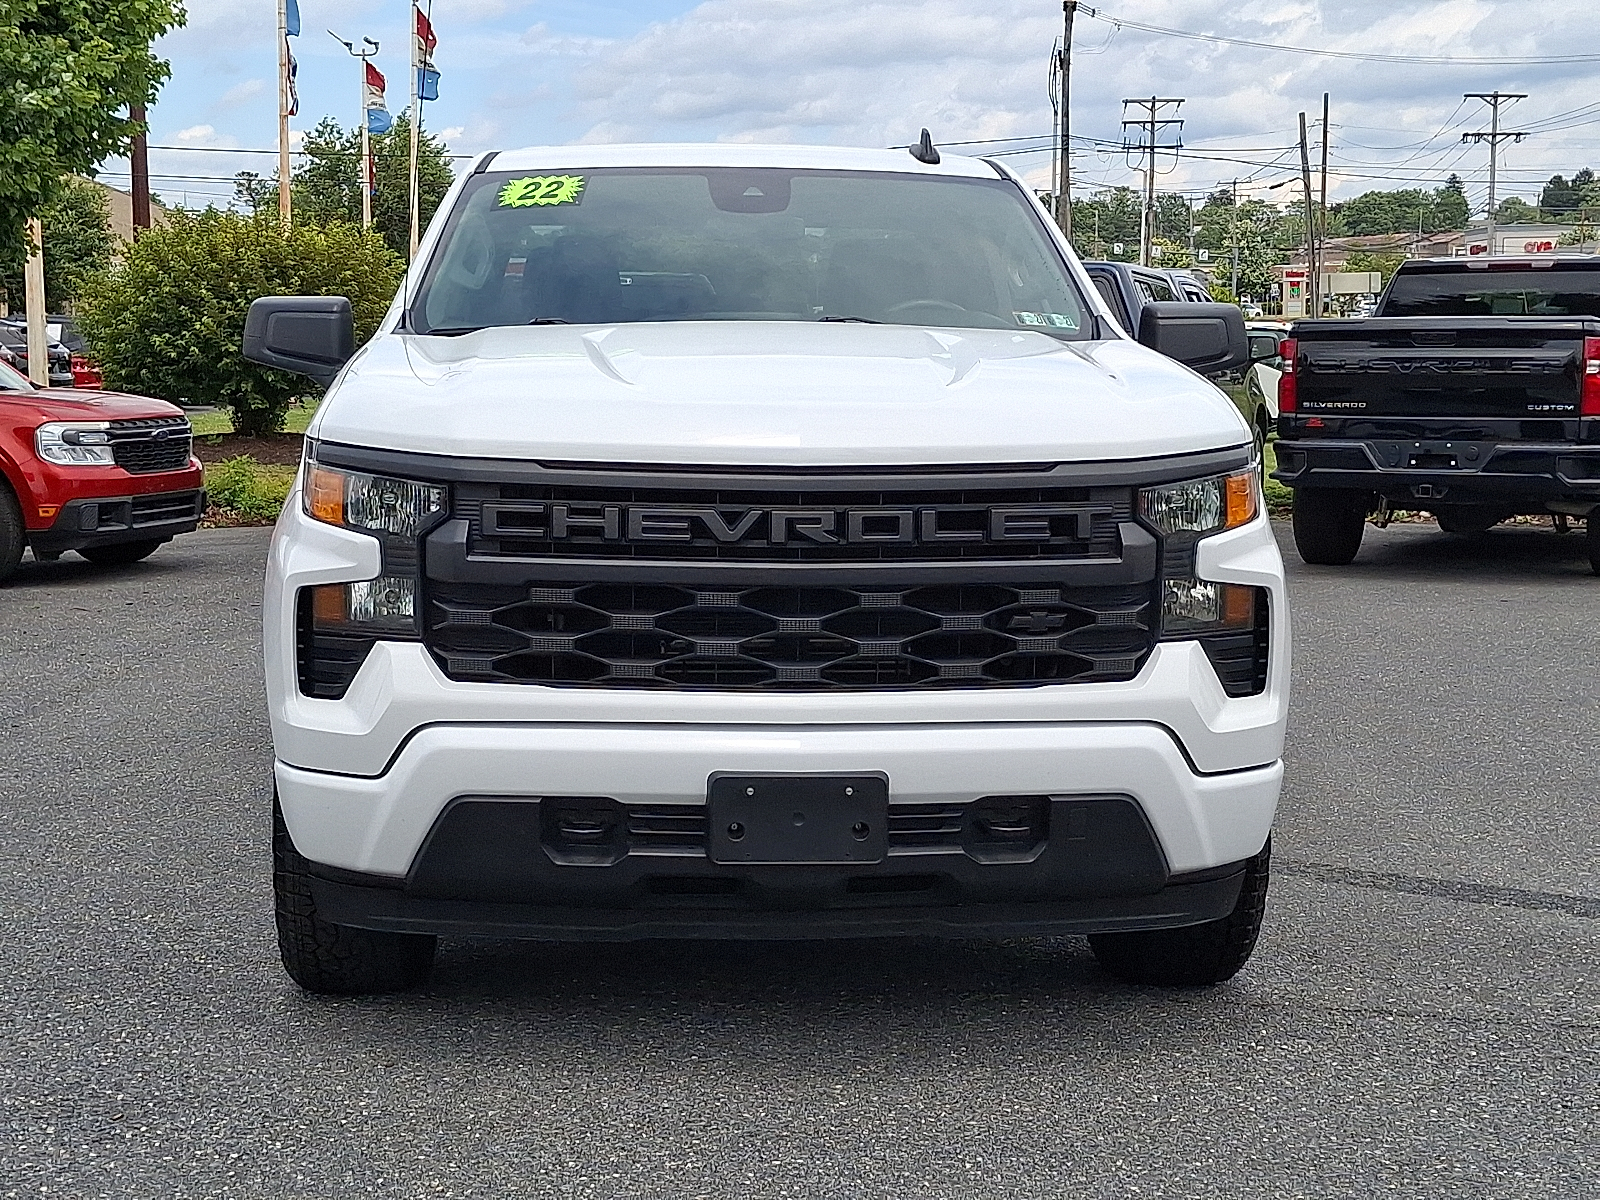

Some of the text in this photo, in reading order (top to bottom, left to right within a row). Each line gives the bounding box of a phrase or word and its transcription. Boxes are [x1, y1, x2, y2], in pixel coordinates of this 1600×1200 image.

[516, 180, 565, 201] 22
[1302, 401, 1367, 409] SILVERADO
[1526, 403, 1576, 411] CUSTOM
[481, 501, 1115, 546] CHEVROLET
